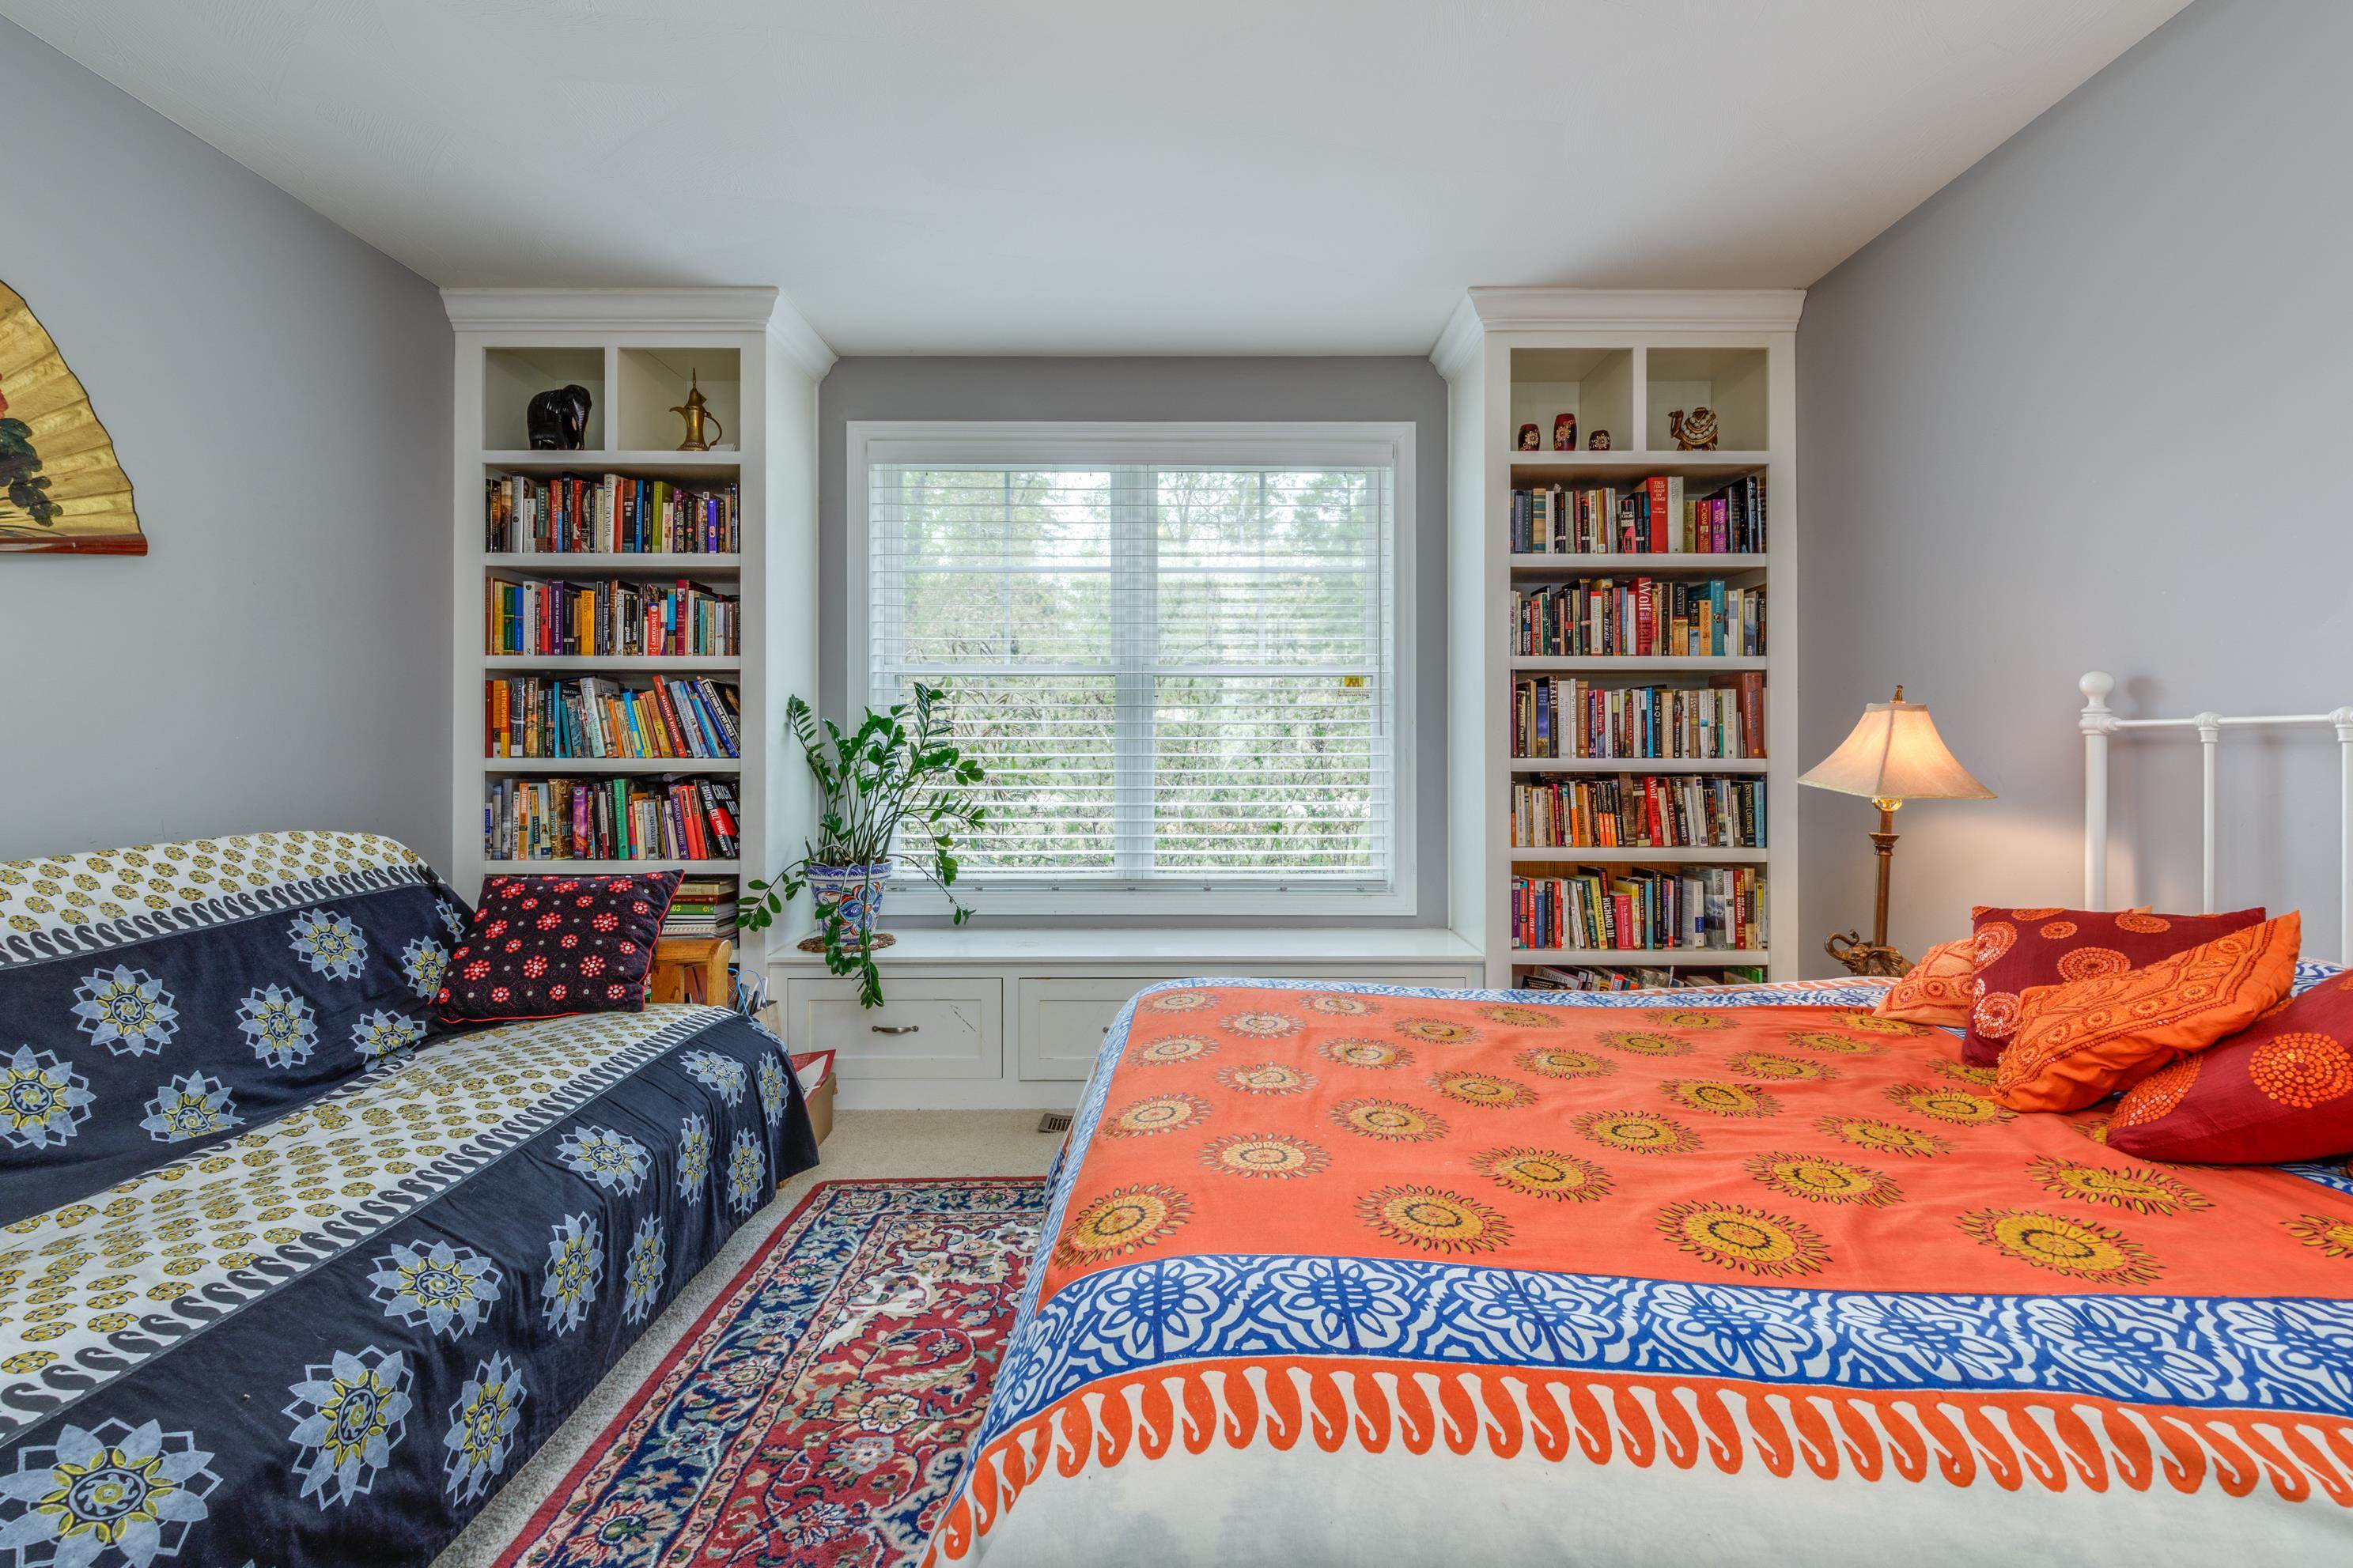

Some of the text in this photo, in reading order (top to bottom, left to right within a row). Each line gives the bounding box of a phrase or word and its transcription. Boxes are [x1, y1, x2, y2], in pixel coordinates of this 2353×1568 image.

[1638, 581, 1651, 644] Wolf Hall
[660, 695, 679, 742] NATASHA'S KITCHEN
[701, 786, 713, 801] CATCH
[677, 822, 686, 844] EMPIRE
[1746, 809, 1754, 833] Cornwell
[1602, 897, 1615, 938] RICHARD III
